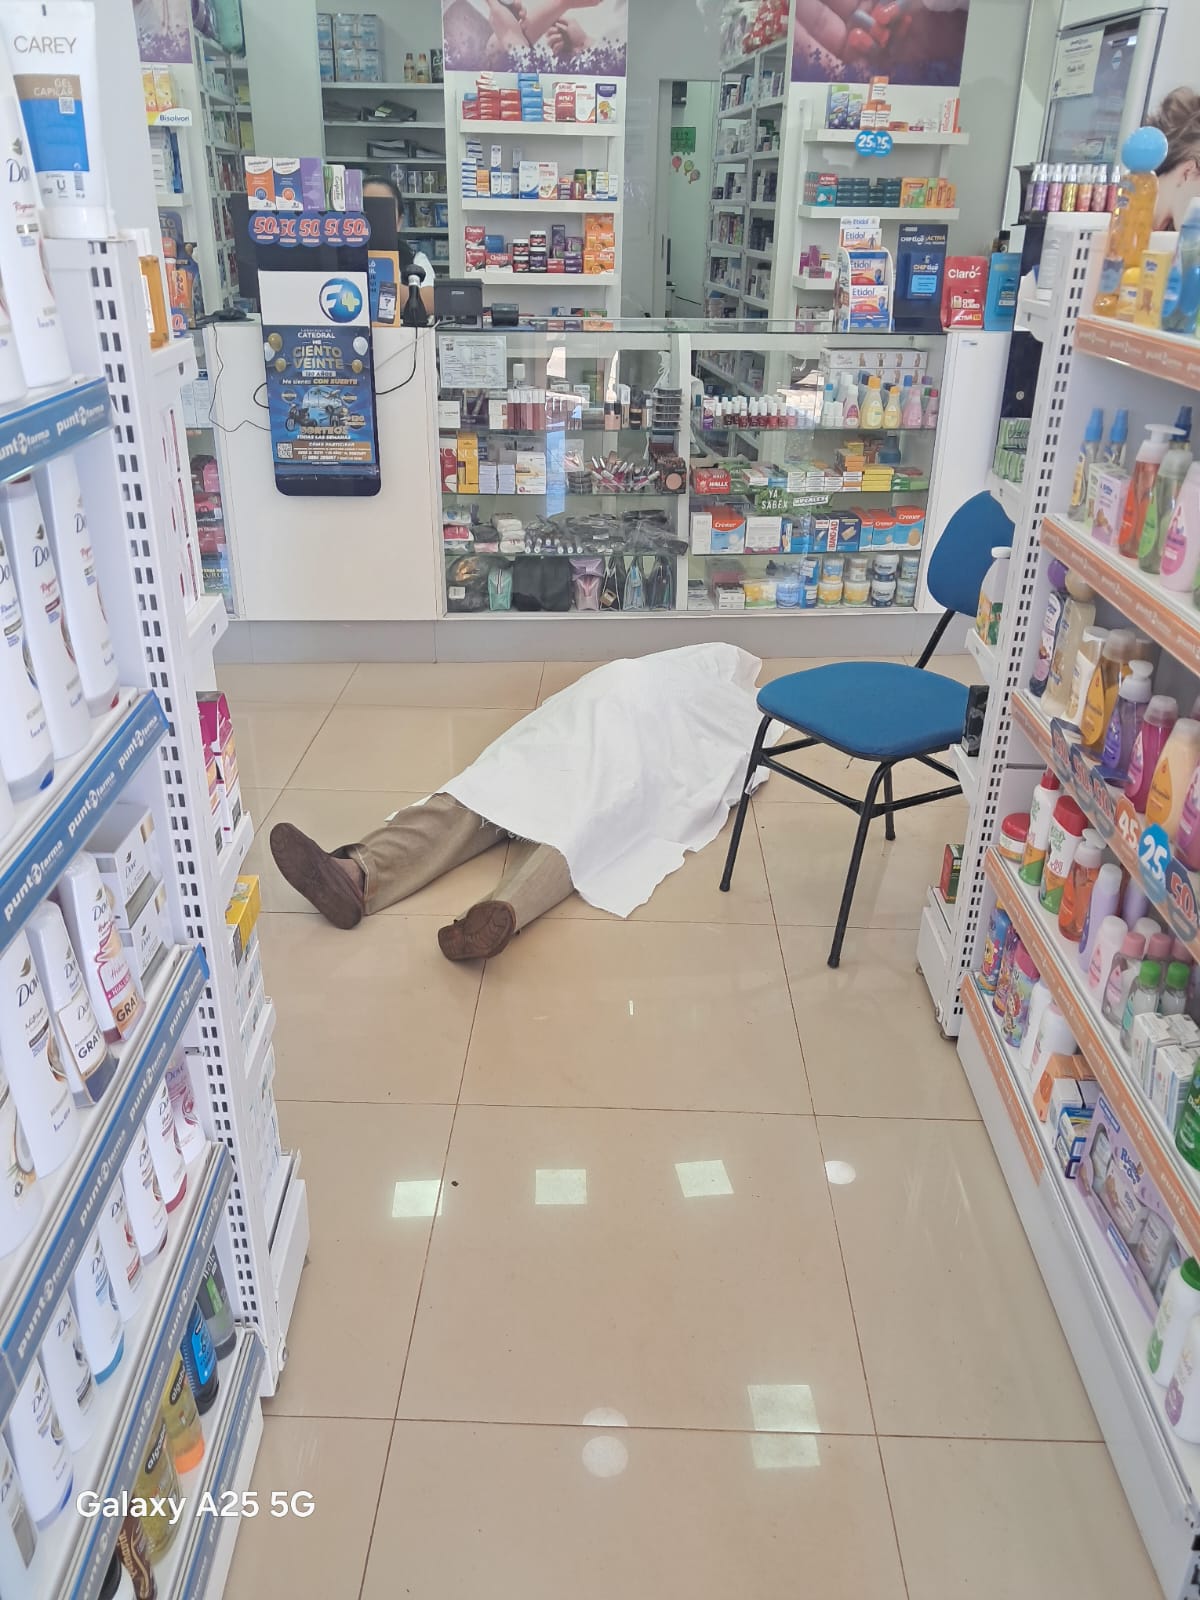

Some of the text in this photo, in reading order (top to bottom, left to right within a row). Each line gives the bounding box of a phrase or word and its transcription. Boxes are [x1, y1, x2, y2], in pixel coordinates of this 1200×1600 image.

[13, 35, 78, 54] CAREY
[159, 113, 190, 124] Bisolvon
[845, 231, 866, 240] Etidol
[948, 269, 977, 279] Claro
[852, 287, 875, 297] Etidol
[293, 345, 343, 358] CIENTO
[294, 357, 345, 370] VEINTE
[768, 489, 778, 498] YA
